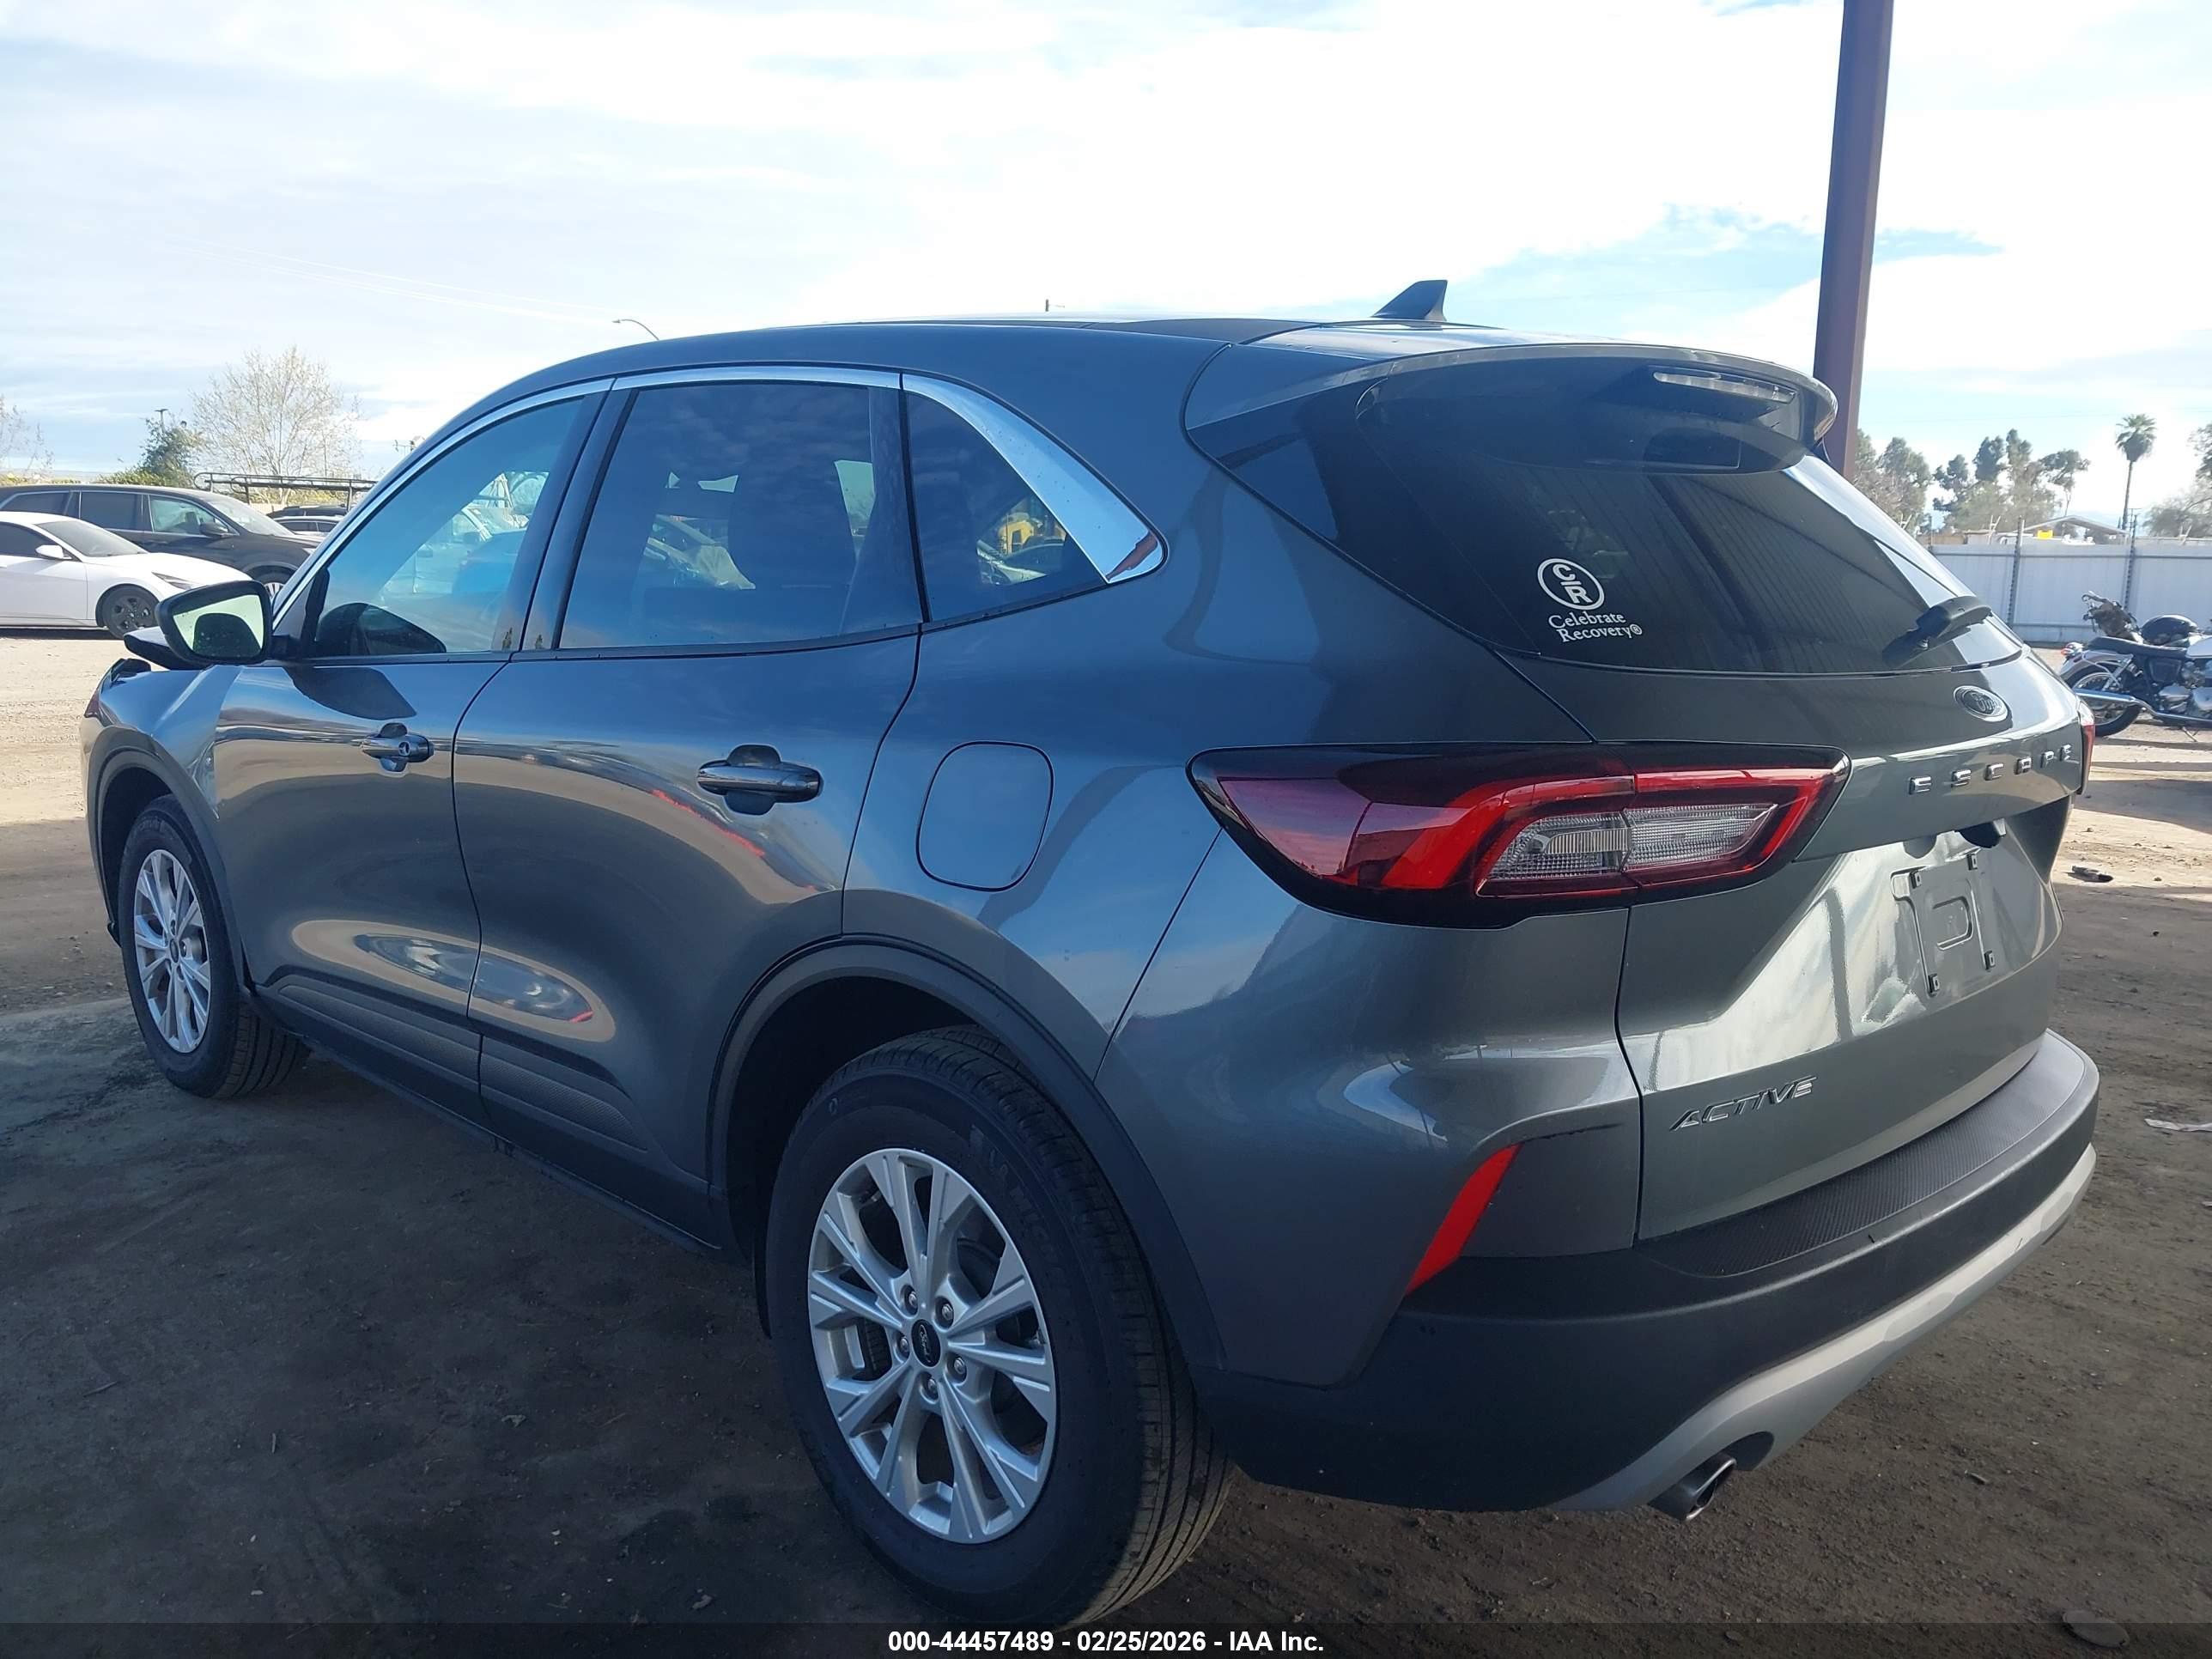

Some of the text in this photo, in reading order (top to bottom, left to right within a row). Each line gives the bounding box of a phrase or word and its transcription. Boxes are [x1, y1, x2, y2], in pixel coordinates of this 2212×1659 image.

[1548, 611, 1626, 629] Celebrate
[1908, 744, 2073, 795] ESCAPE
[1669, 1075, 1817, 1131] ACTIVE
